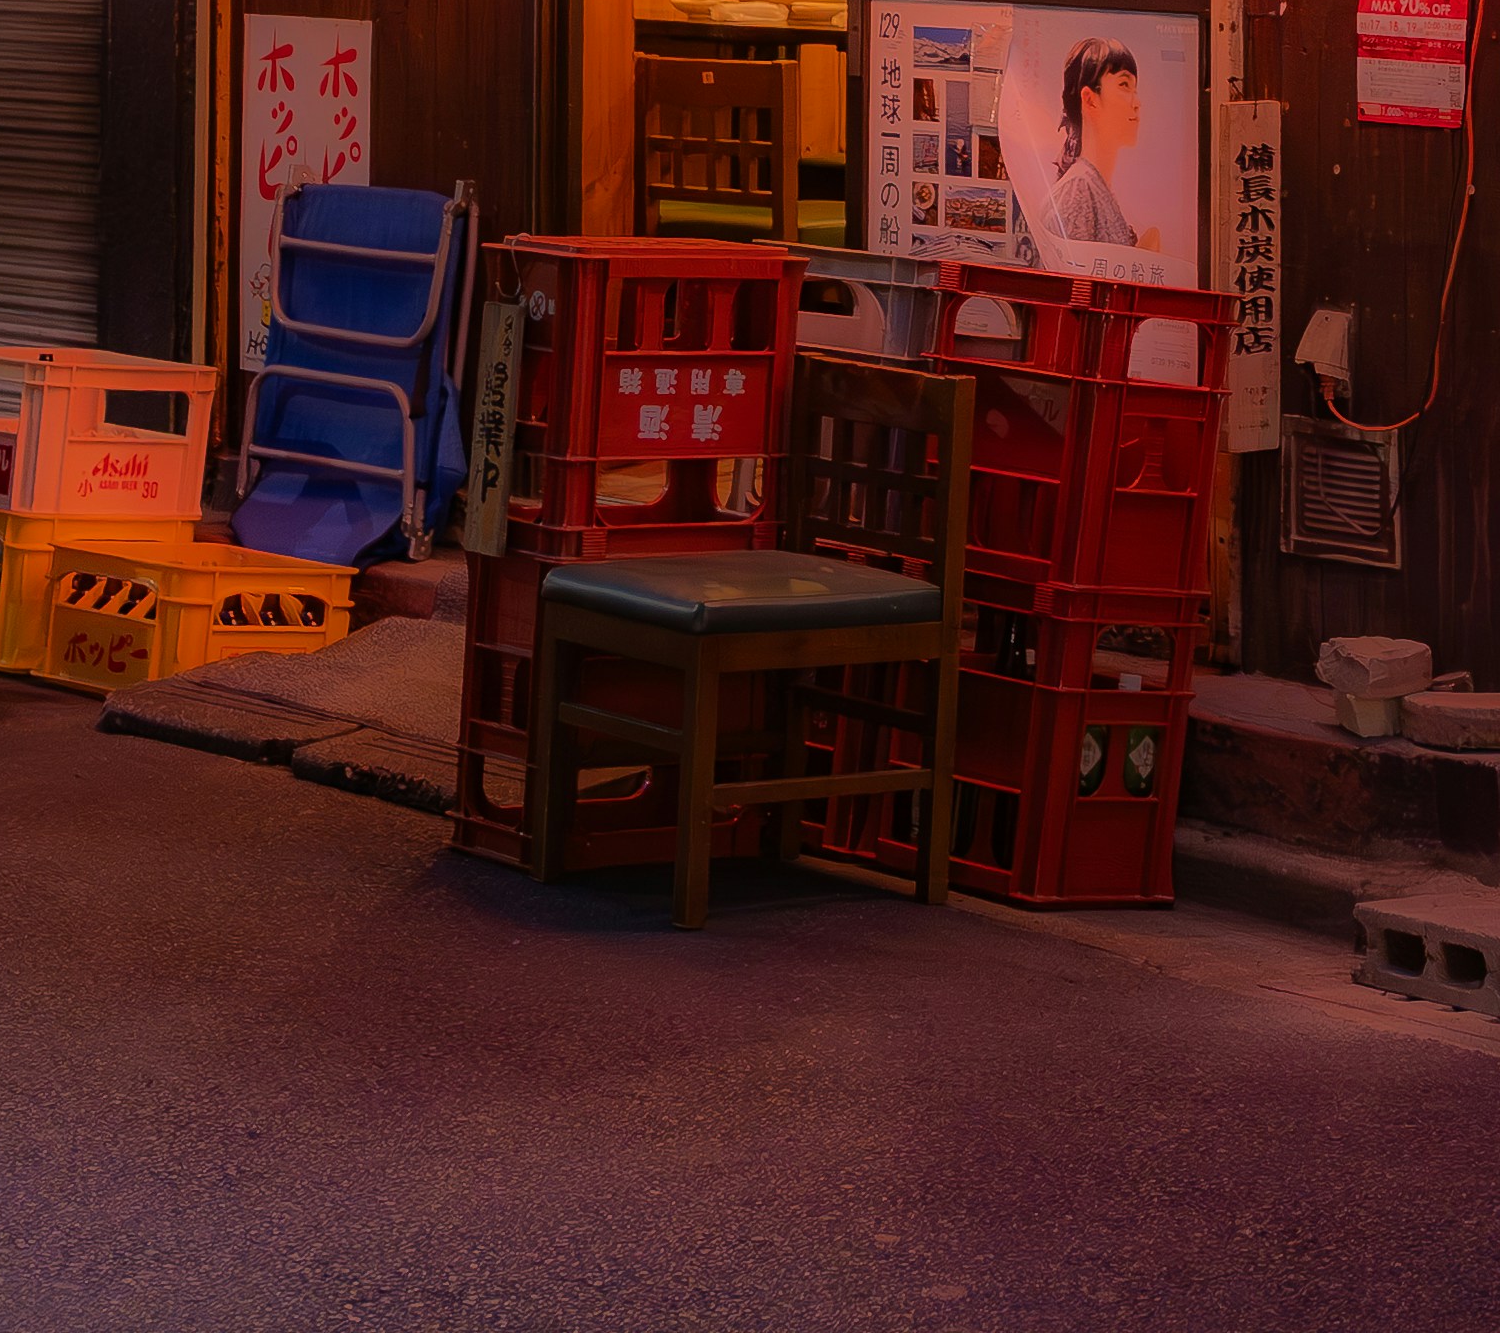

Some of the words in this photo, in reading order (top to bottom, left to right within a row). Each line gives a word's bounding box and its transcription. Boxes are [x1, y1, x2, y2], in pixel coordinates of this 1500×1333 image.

[1371, 0, 1396, 13] MAX
[1432, 3, 1452, 16] OFF
[878, 11, 901, 39] 129
[879, 56, 903, 254] 地球一周の船
[618, 367, 746, 397] 専用通箱
[637, 403, 724, 442] 清酒
[91, 452, 150, 479] Asahi
[77, 479, 93, 498] 小
[63, 631, 149, 674] ホッピー
